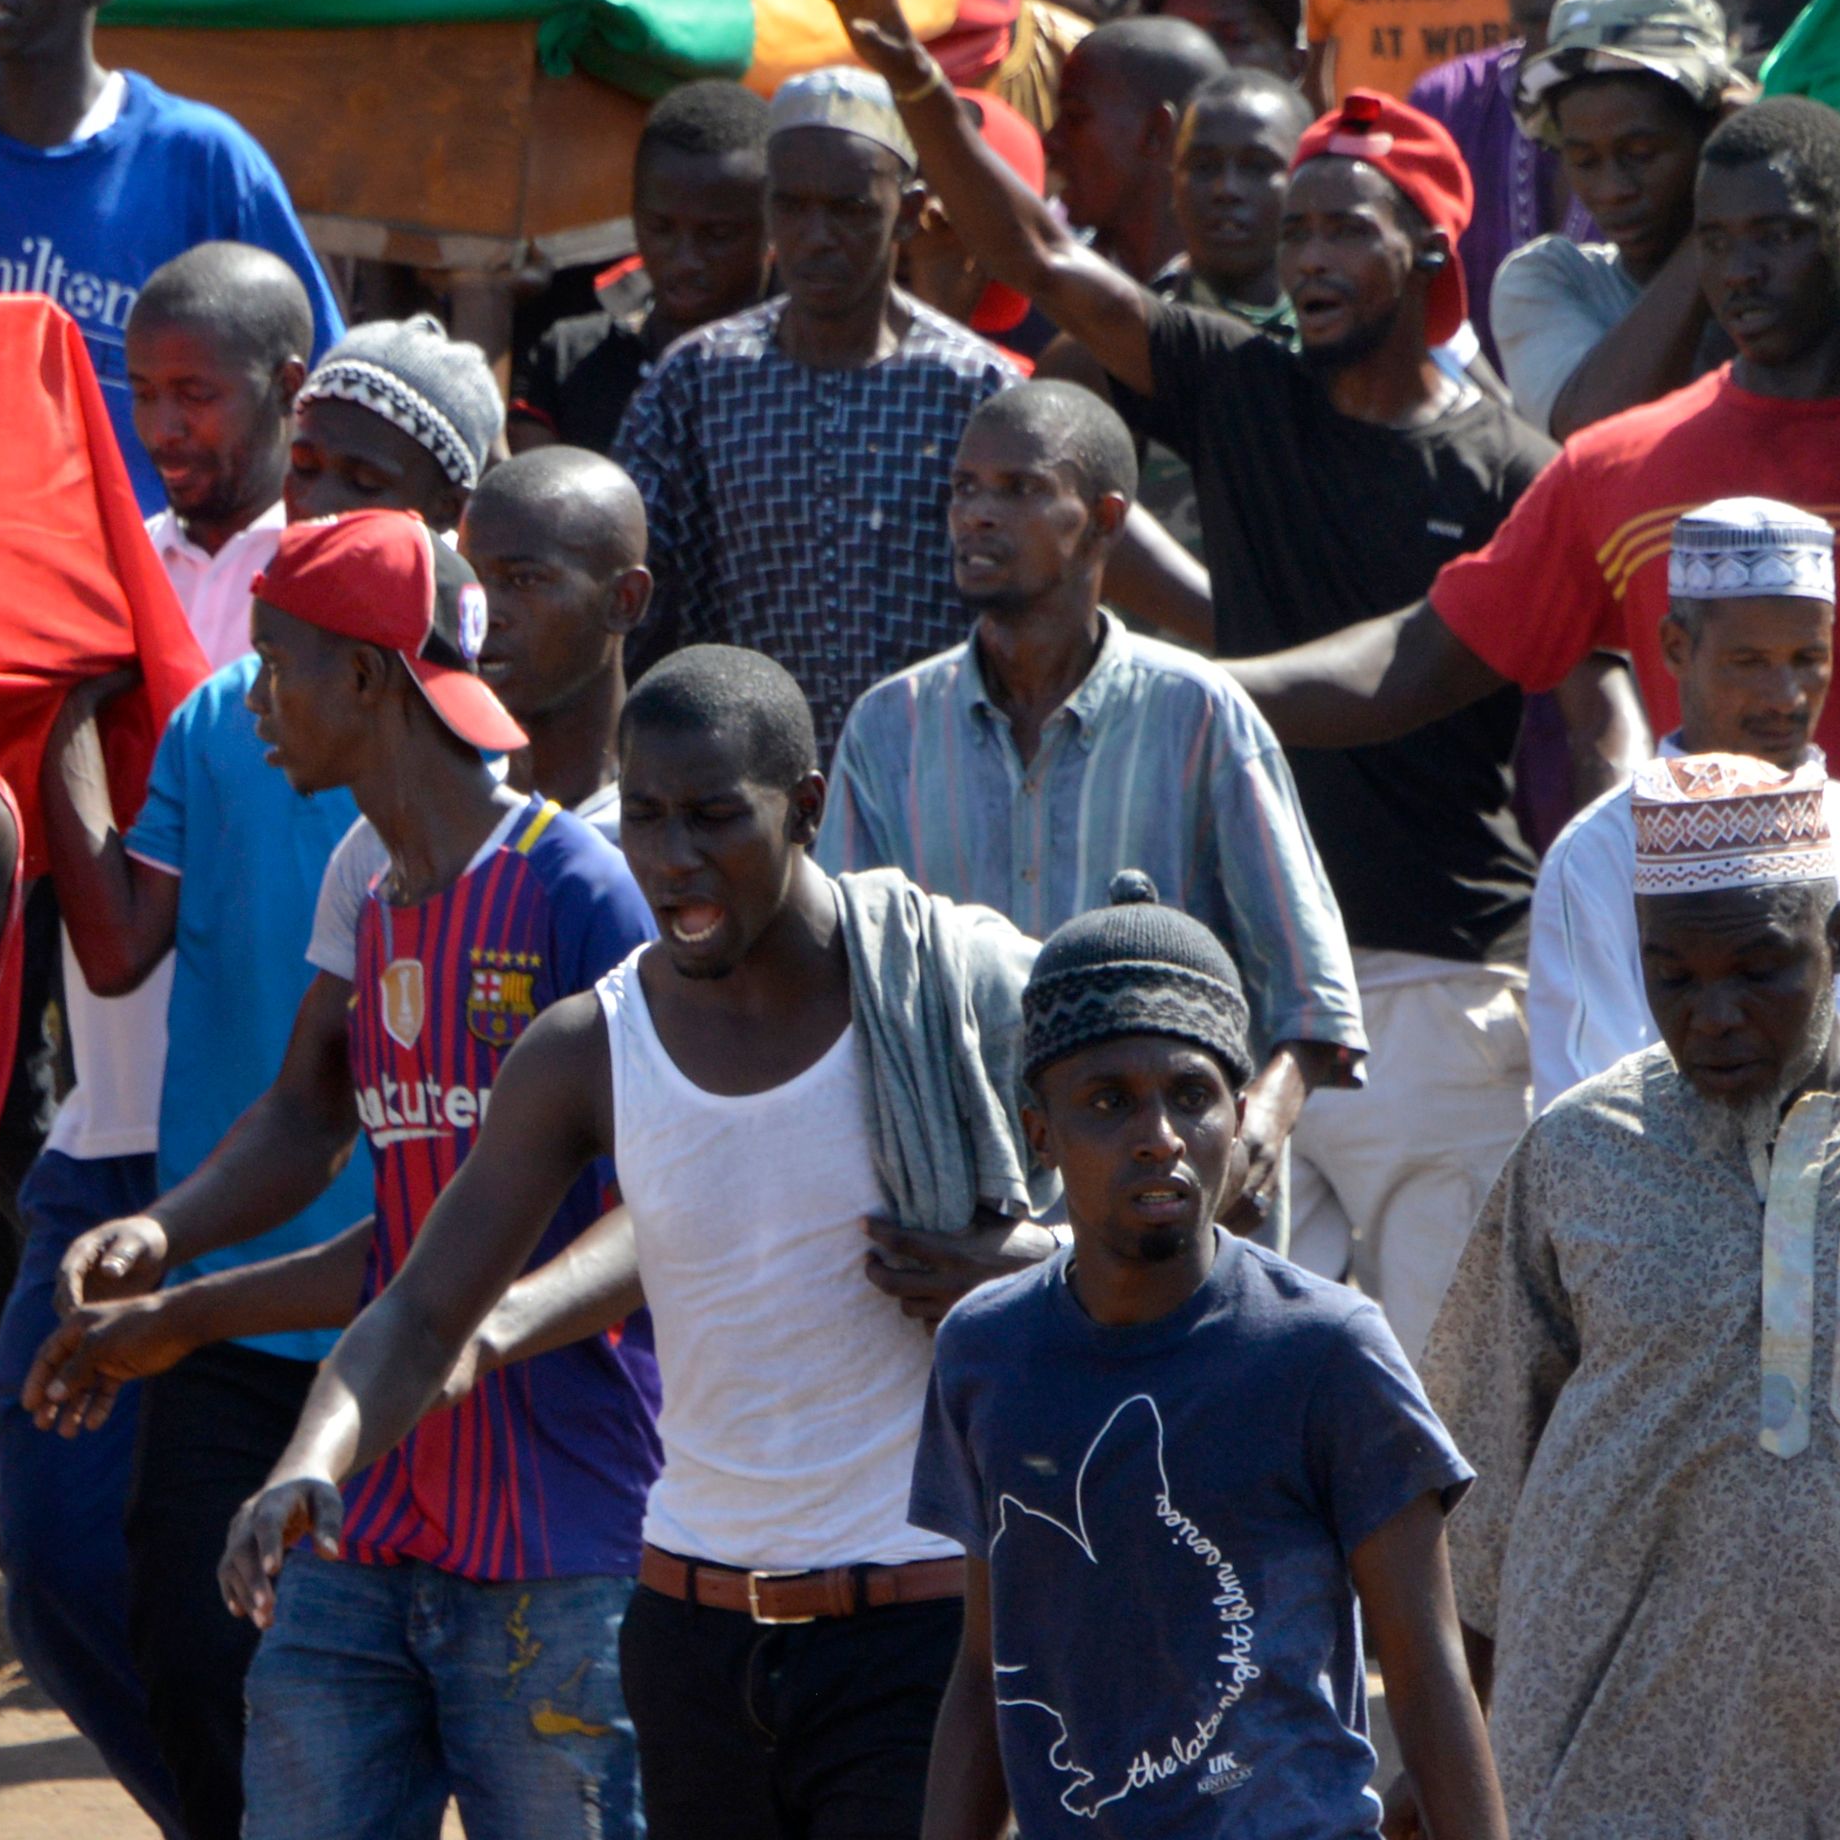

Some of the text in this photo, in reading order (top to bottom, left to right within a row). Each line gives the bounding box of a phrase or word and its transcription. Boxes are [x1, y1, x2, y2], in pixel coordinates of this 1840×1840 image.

[1127, 1751, 1178, 1789] the
[1172, 1712, 1224, 1765] late
[1215, 1623, 1262, 1710] night
